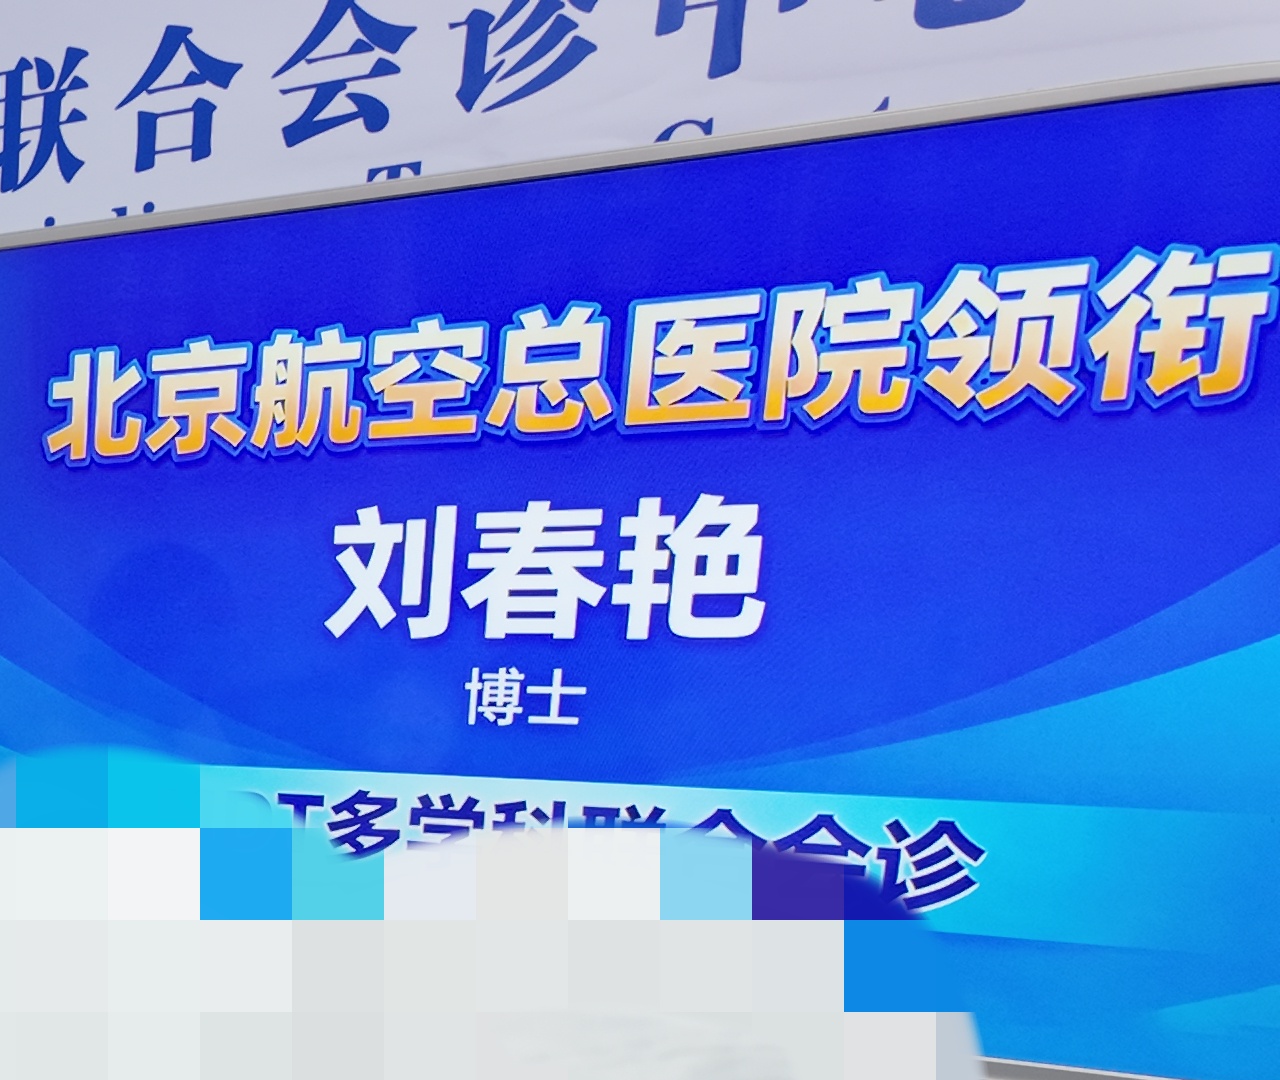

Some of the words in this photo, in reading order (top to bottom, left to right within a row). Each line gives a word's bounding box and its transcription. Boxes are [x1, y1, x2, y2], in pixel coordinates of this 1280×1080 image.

[48, 246, 1272, 463] 北京航空总医院领衔
[324, 492, 767, 641] 刘春艳
[463, 667, 588, 728] 博士
